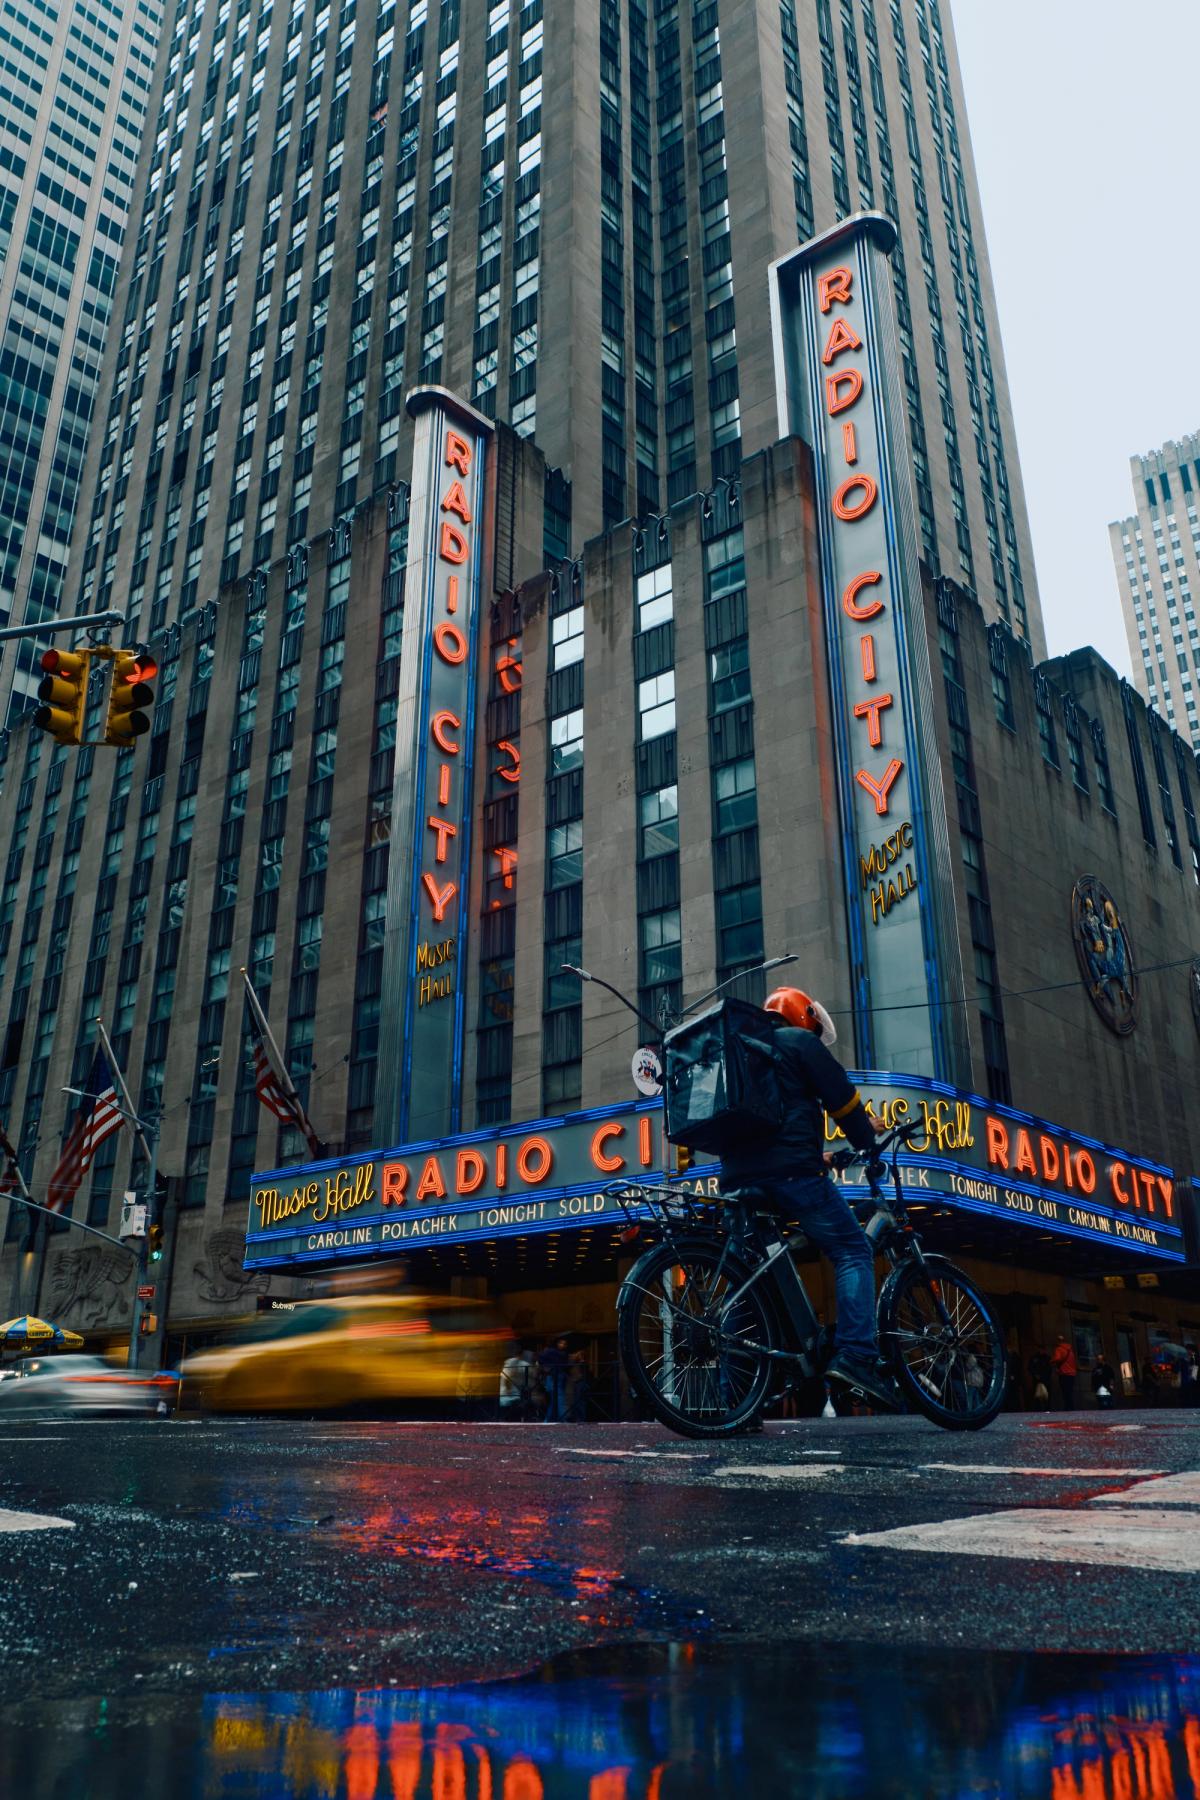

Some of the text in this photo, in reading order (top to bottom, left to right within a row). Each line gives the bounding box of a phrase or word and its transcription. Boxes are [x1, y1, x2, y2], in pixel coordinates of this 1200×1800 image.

[817, 265, 904, 816] RADIO CITY
[423, 431, 472, 922] RADIO CITY
[381, 1117, 653, 1206] RADIO CI
[907, 1100, 974, 1152] Hall
[256, 1163, 374, 1228] Music Hall
[986, 1116, 1174, 1218] RADIO CITY
[308, 1227, 372, 1250] CAROLINE
[382, 1214, 457, 1240] POLACHEK
[479, 1202, 545, 1226] TONIGHT
[559, 1193, 605, 1217] SOLD
[949, 1174, 997, 1203] TONIGHT
[1005, 1190, 1033, 1212] SOLD
[1038, 1199, 1057, 1219] OUT
[1069, 1207, 1112, 1234] CAROLINE
[1115, 1220, 1158, 1245] POLACHEK
[272, 1301, 295, 1311] Subway
